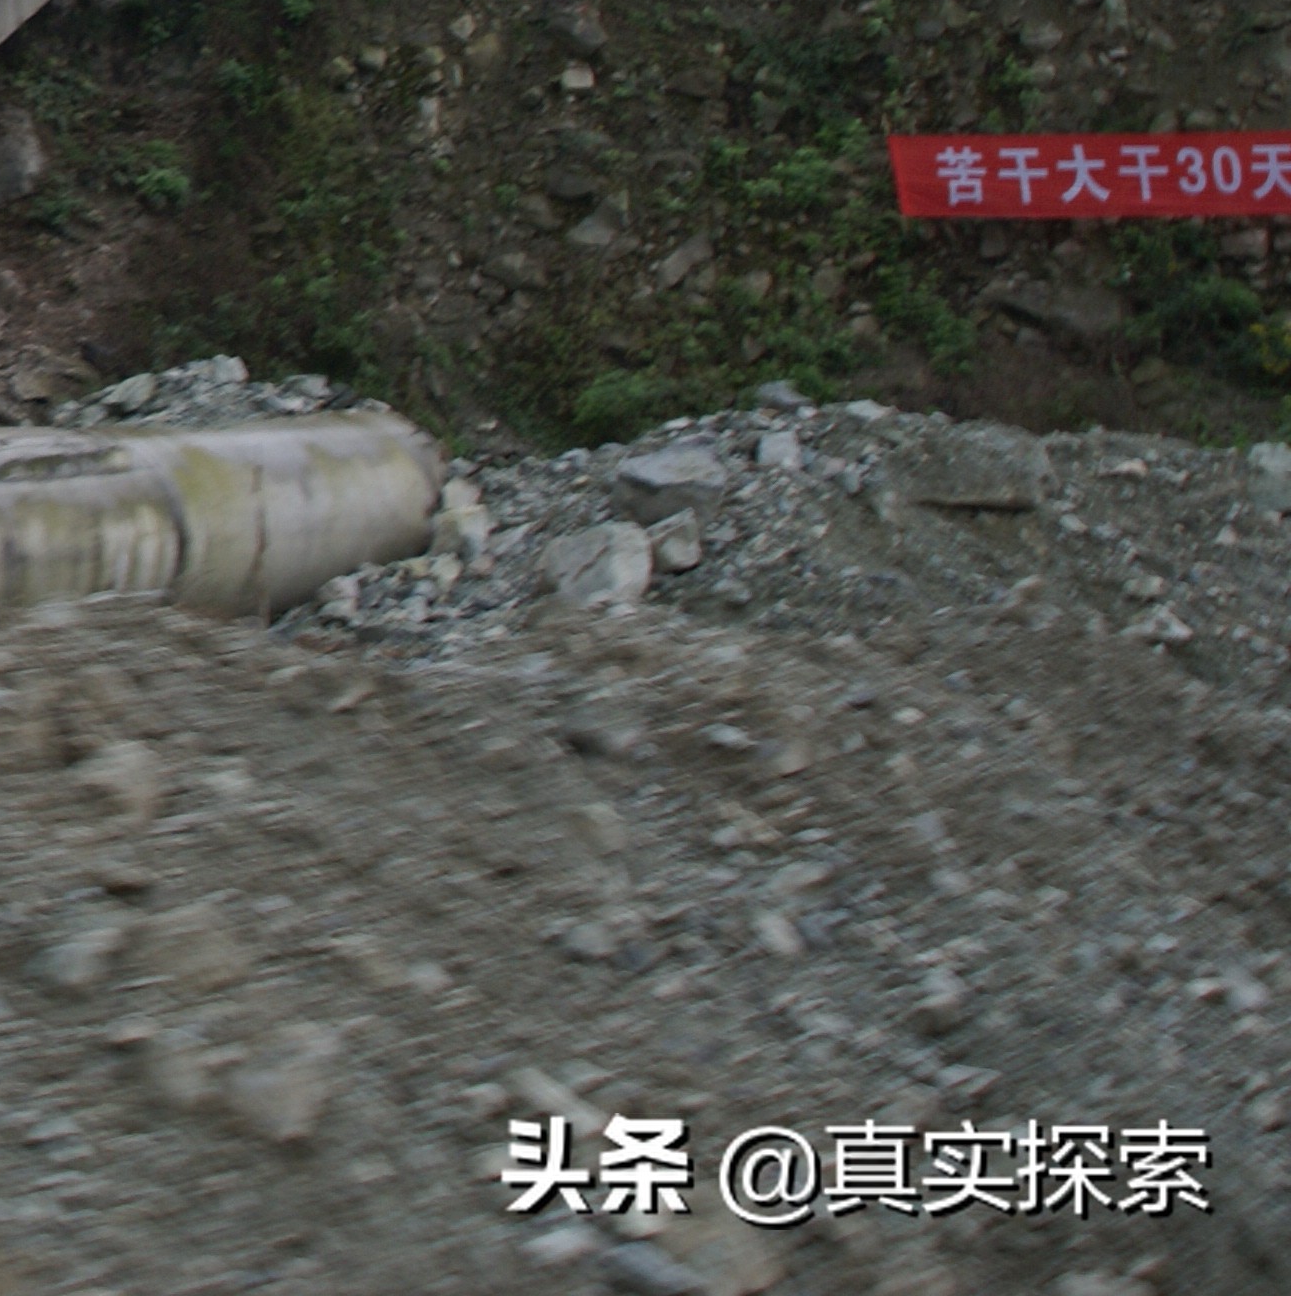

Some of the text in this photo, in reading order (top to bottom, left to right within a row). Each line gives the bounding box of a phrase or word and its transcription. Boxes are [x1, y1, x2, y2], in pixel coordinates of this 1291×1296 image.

[935, 143, 1291, 207] 苦干大干30天
